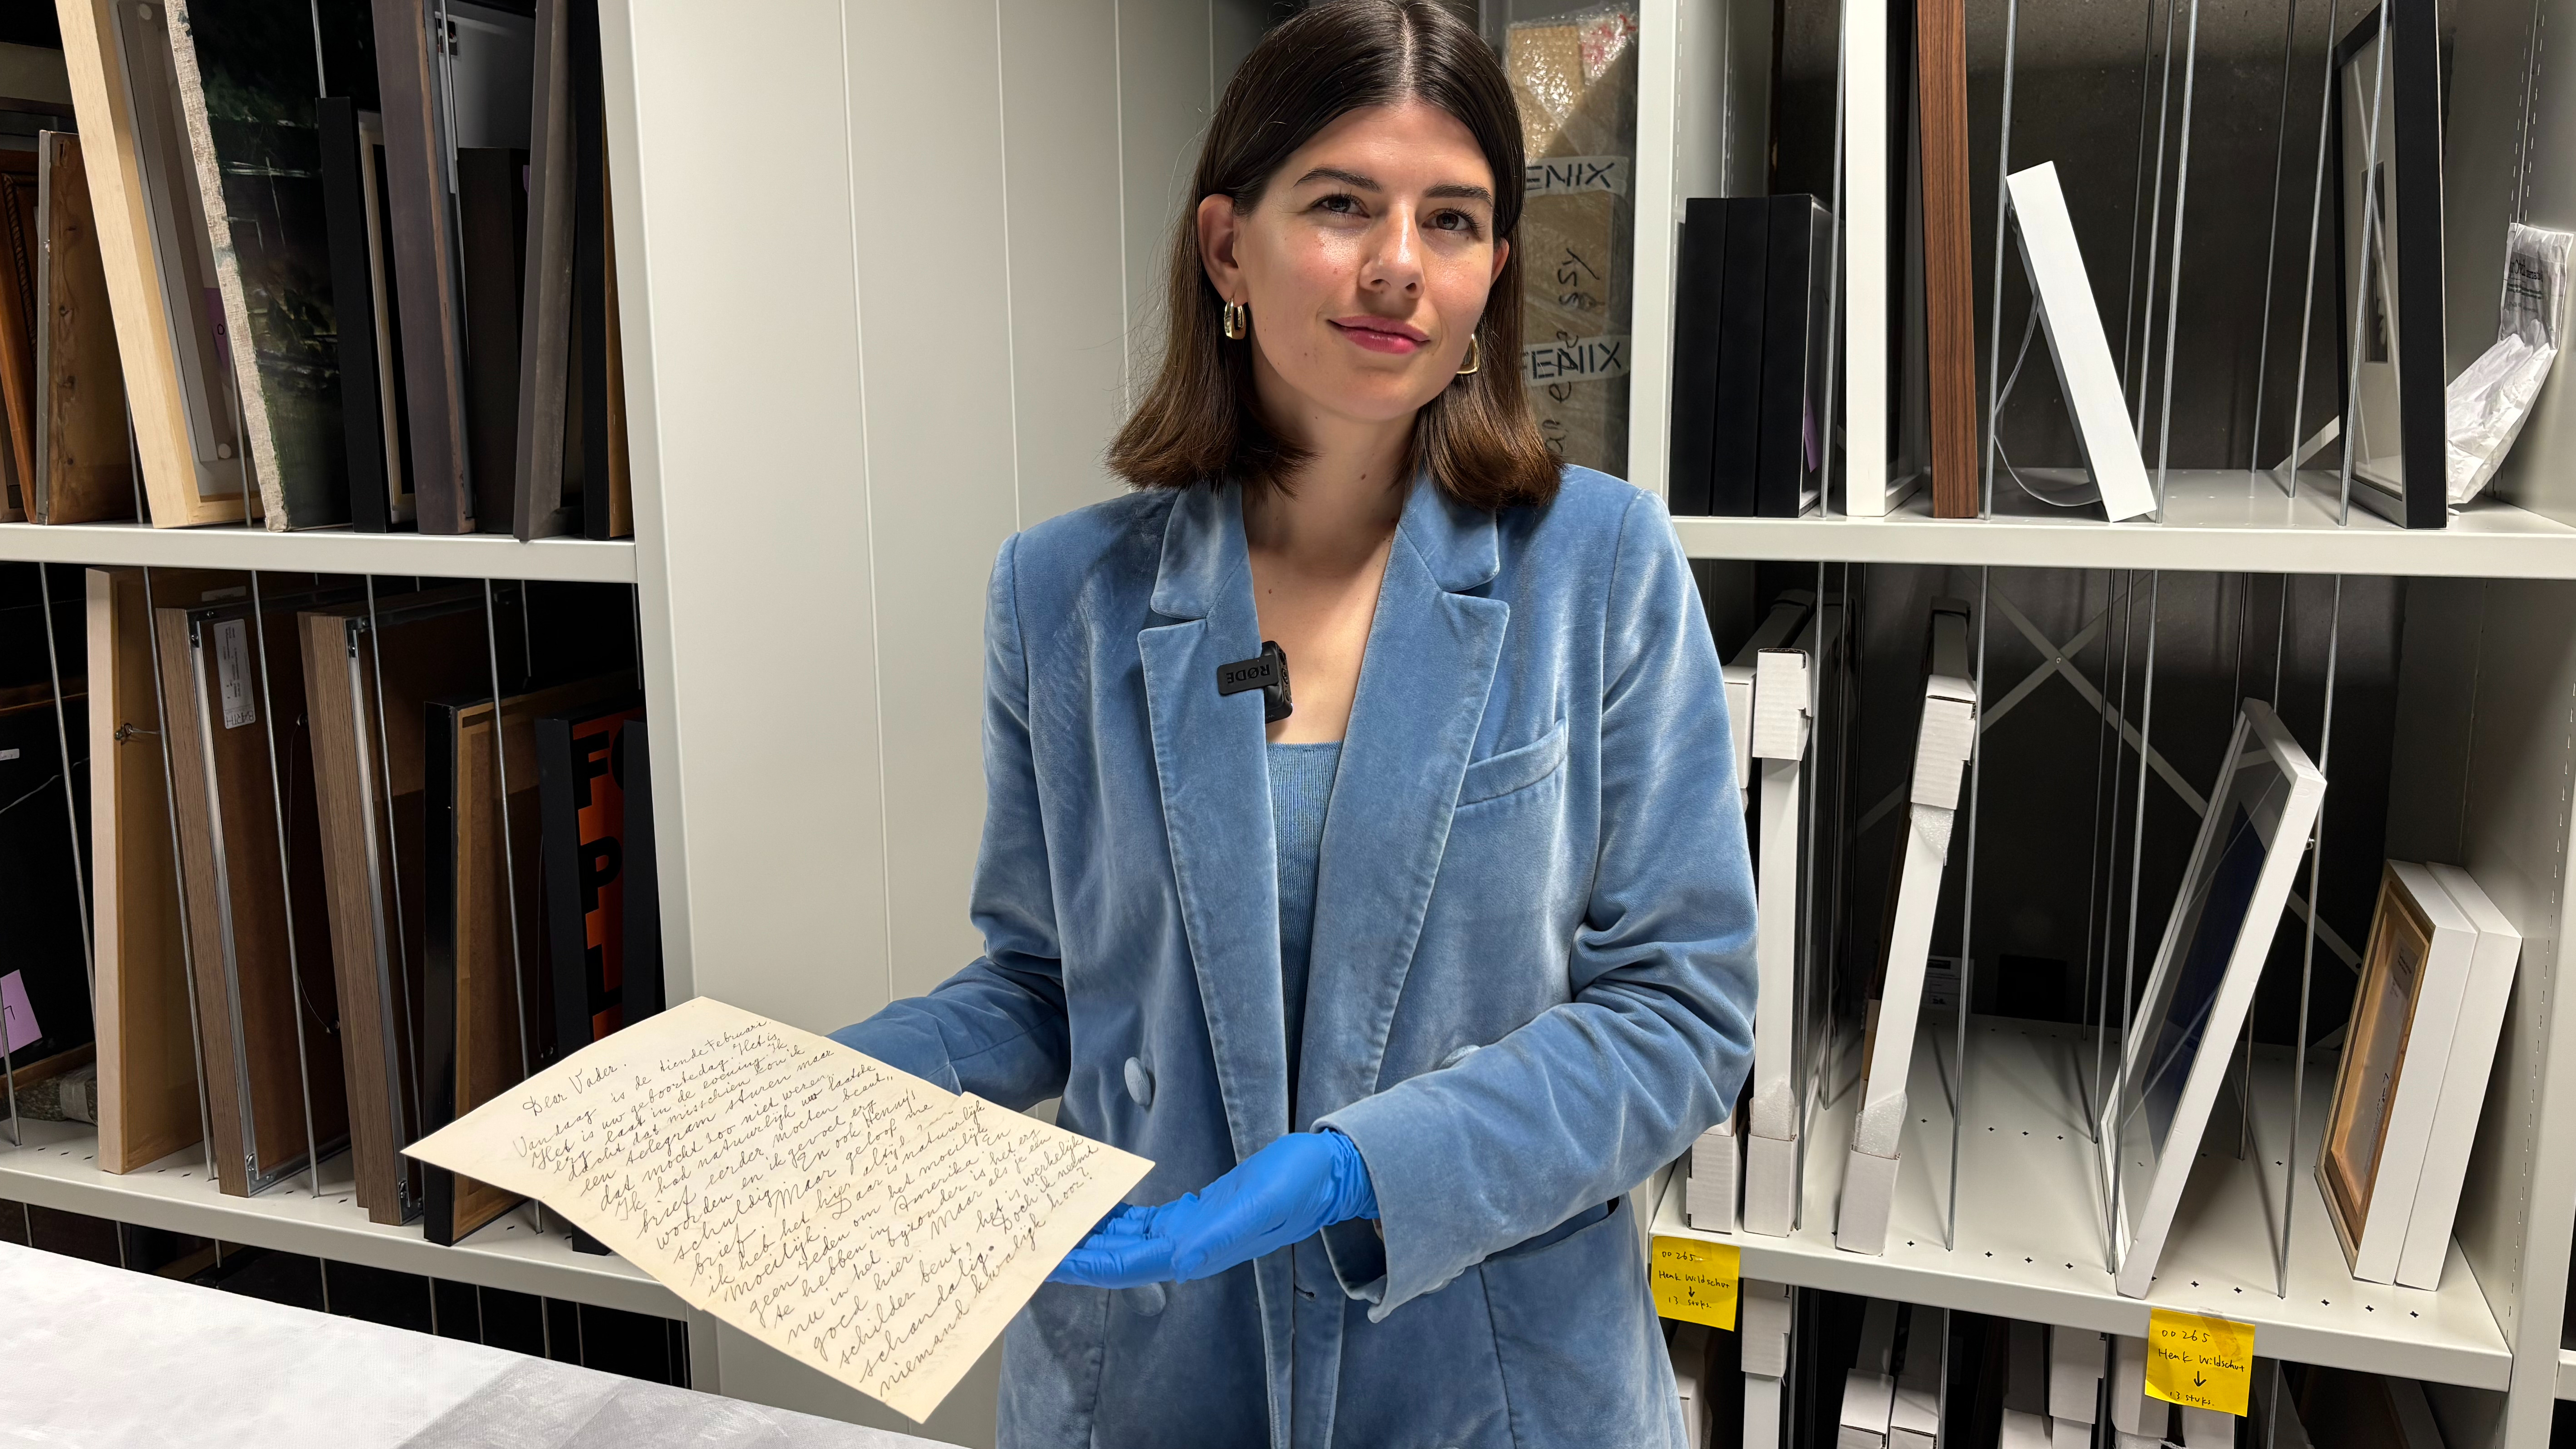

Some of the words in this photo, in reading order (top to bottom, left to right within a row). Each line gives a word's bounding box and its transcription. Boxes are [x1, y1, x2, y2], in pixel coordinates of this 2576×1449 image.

[1524, 341, 1622, 379] ENIX
[1226, 664, 1270, 684] RØDE
[512, 1108, 597, 1158] Vandaag
[611, 1091, 625, 1103] is
[635, 1075, 652, 1091] de
[660, 1048, 709, 1072] tiende
[522, 1093, 568, 1117] Dear
[531, 1138, 575, 1170] Het
[581, 1130, 594, 1142] is
[602, 1112, 626, 1130] uw
[733, 1034, 766, 1056] Het
[767, 1032, 777, 1041] is
[553, 1150, 593, 1174] erg
[604, 1115, 646, 1146] laat
[651, 1106, 671, 1118] in
[678, 1089, 696, 1104] de
[767, 1037, 788, 1054] Ik
[569, 1142, 626, 1182] dacht
[667, 1078, 751, 1124] misschien
[786, 1044, 805, 1058] ik
[580, 1169, 617, 1198] een
[625, 1113, 716, 1167] telegram
[725, 1075, 791, 1114] sturen
[796, 1050, 834, 1072] maar
[615, 1190, 647, 1221] Ik
[654, 1165, 692, 1198] had
[801, 1088, 823, 1107] uw
[828, 1064, 876, 1092] laatste
[642, 1140, 704, 1183] mocht
[741, 1096, 780, 1126] niet
[797, 1148, 831, 1172] En
[835, 1122, 862, 1149] ook
[636, 1184, 697, 1239] brief
[705, 1147, 764, 1190] eerder
[772, 1105, 838, 1148] moeten
[656, 1193, 733, 1250] woorden
[741, 1174, 764, 1190] en
[766, 1152, 786, 1171] ik
[788, 1115, 846, 1169] gevoel
[851, 1099, 877, 1118] erg
[774, 1169, 837, 1218] Maar
[846, 1118, 897, 1176] geloof
[905, 1104, 934, 1121] me
[825, 1180, 883, 1220] Daar
[884, 1162, 897, 1175] is
[991, 1194, 1038, 1235] Doch
[1035, 1175, 1056, 1194] ik
[708, 1263, 735, 1298] ik
[738, 1233, 776, 1271] heb
[780, 1211, 810, 1241] het
[815, 1183, 851, 1214] hier
[749, 1274, 799, 1329] geen
[853, 1204, 881, 1227] om
[887, 1172, 915, 1202] het
[774, 1304, 795, 1329] te
[802, 1243, 867, 1297] hebben
[869, 1225, 890, 1240] in
[982, 1128, 1011, 1146] En
[787, 1309, 825, 1345] nu
[825, 1287, 849, 1306] in
[852, 1249, 881, 1282] het
[969, 1168, 986, 1181] is
[989, 1141, 1016, 1166] het
[1019, 1129, 1041, 1147] erg
[814, 1295, 869, 1363] goed
[931, 1190, 983, 1240] Maar
[988, 1166, 1008, 1187] als
[1013, 1153, 1027, 1175] je
[1029, 1135, 1051, 1155] een
[839, 1292, 916, 1369] schilder
[976, 1198, 1004, 1233] het
[1005, 1189, 1020, 1202] is
[1659, 1270, 1681, 1282] Henk
[880, 1299, 970, 1398] niemand
[1668, 1295, 1679, 1305] 13
[2158, 1348, 2193, 1363] Henk
[2169, 1391, 2181, 1400] 13
